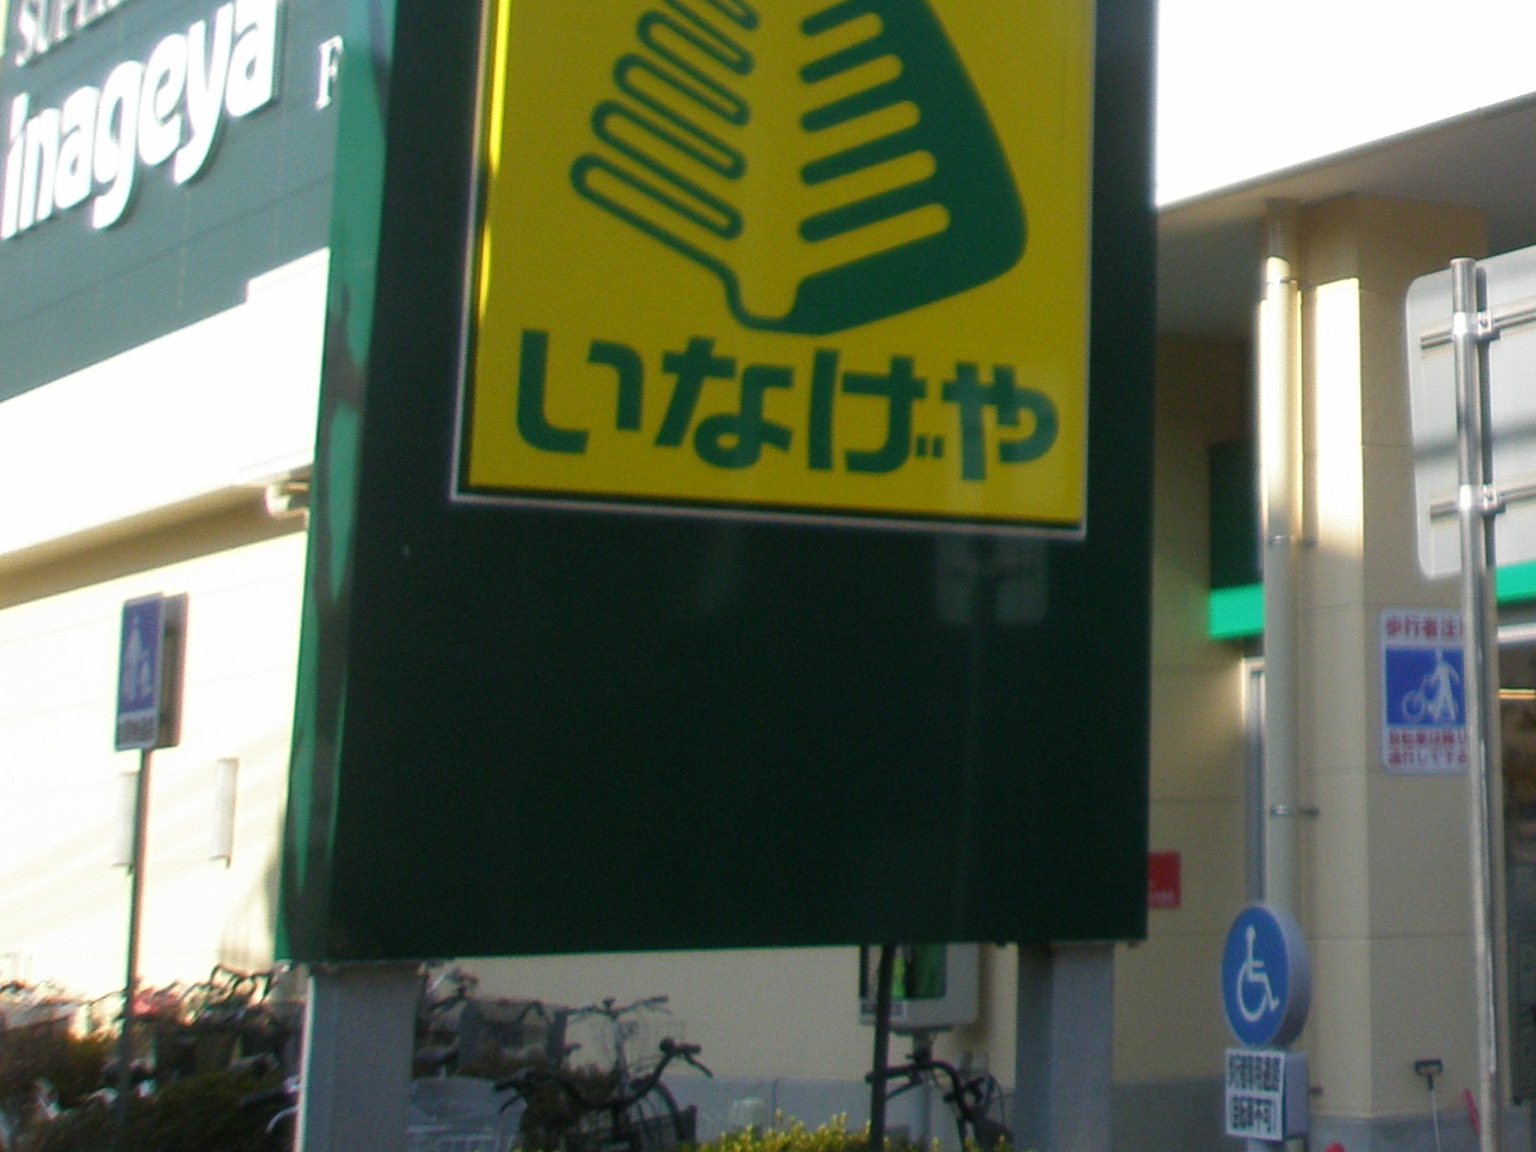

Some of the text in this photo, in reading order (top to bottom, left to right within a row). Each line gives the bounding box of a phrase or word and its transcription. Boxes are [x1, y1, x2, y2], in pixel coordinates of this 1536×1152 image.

[515, 329, 1060, 482] いなげや
[1386, 614, 1463, 637] 歩行者注
